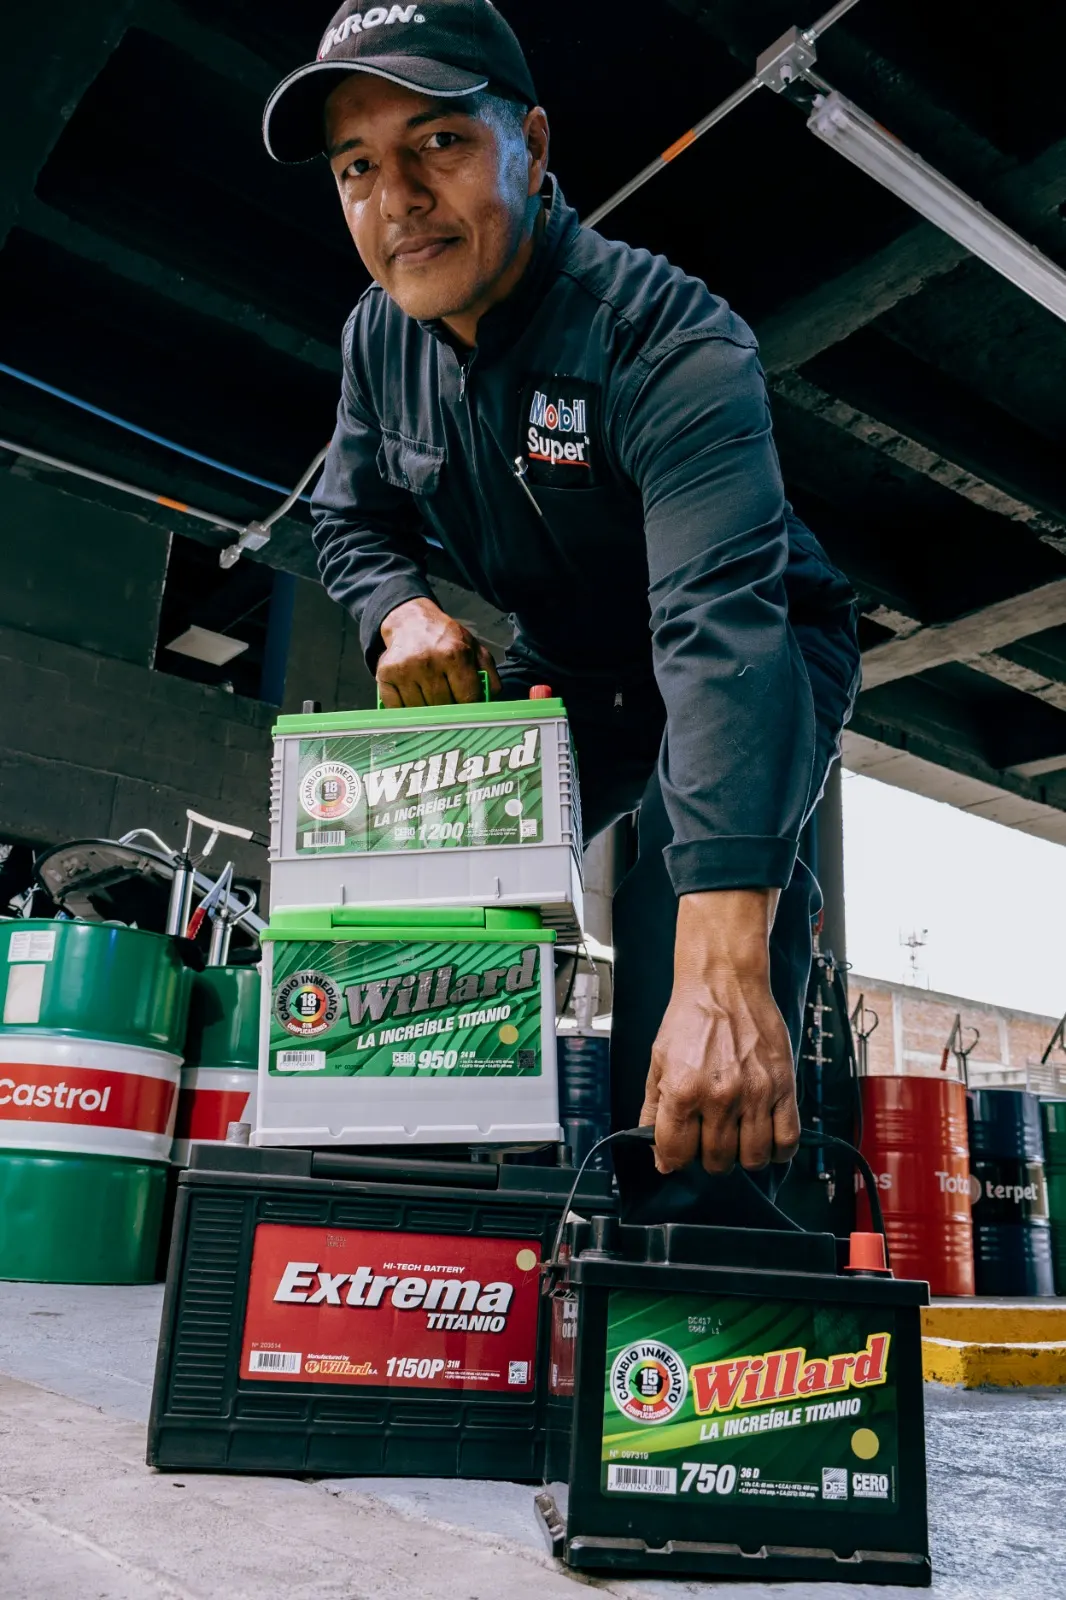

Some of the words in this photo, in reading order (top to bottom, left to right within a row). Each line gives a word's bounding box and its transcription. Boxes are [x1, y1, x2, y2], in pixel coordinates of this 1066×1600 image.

[529, 390, 586, 433] Mobil
[527, 427, 585, 465] Super
[363, 728, 539, 808] Willard
[305, 770, 322, 806] CAMBIO
[324, 766, 356, 804] INMEDIATO
[324, 781, 338, 793] 18
[374, 813, 390, 828] LA
[394, 794, 462, 822] INCREÍBLE
[465, 780, 514, 803] TITANIO
[418, 822, 464, 841] 1200
[278, 979, 299, 1021] CAMBIO
[301, 975, 338, 1021] INMEDIATO
[301, 993, 317, 1007] 18
[344, 948, 537, 1026] Willard
[356, 1034, 376, 1050] LA
[379, 1018, 454, 1046] INCREÍBLE
[458, 1005, 511, 1029] TITANIO
[392, 1053, 416, 1064] CERO
[418, 1050, 458, 1070] 950
[0, 1079, 111, 1112] Castrol
[934, 1171, 971, 1195] Tota
[986, 1180, 1038, 1204] terpel
[383, 1262, 422, 1272] HI-TECH
[424, 1264, 465, 1275] BATTERY
[273, 1261, 514, 1314] Extrema
[427, 1313, 506, 1333] TITANIO
[319, 1360, 372, 1375] Willard
[386, 1356, 444, 1379] 1150P
[616, 1349, 640, 1401] CAMBIO
[641, 1347, 682, 1404] INMEDIATO
[640, 1368, 659, 1385] 15
[690, 1332, 890, 1415] Willard
[700, 1423, 719, 1441] LA
[723, 1408, 801, 1437] INCREÍBLE
[805, 1398, 861, 1424] TITANIO
[680, 1462, 737, 1495] 750
[740, 1467, 752, 1478] 36
[852, 1473, 889, 1492] CERO
